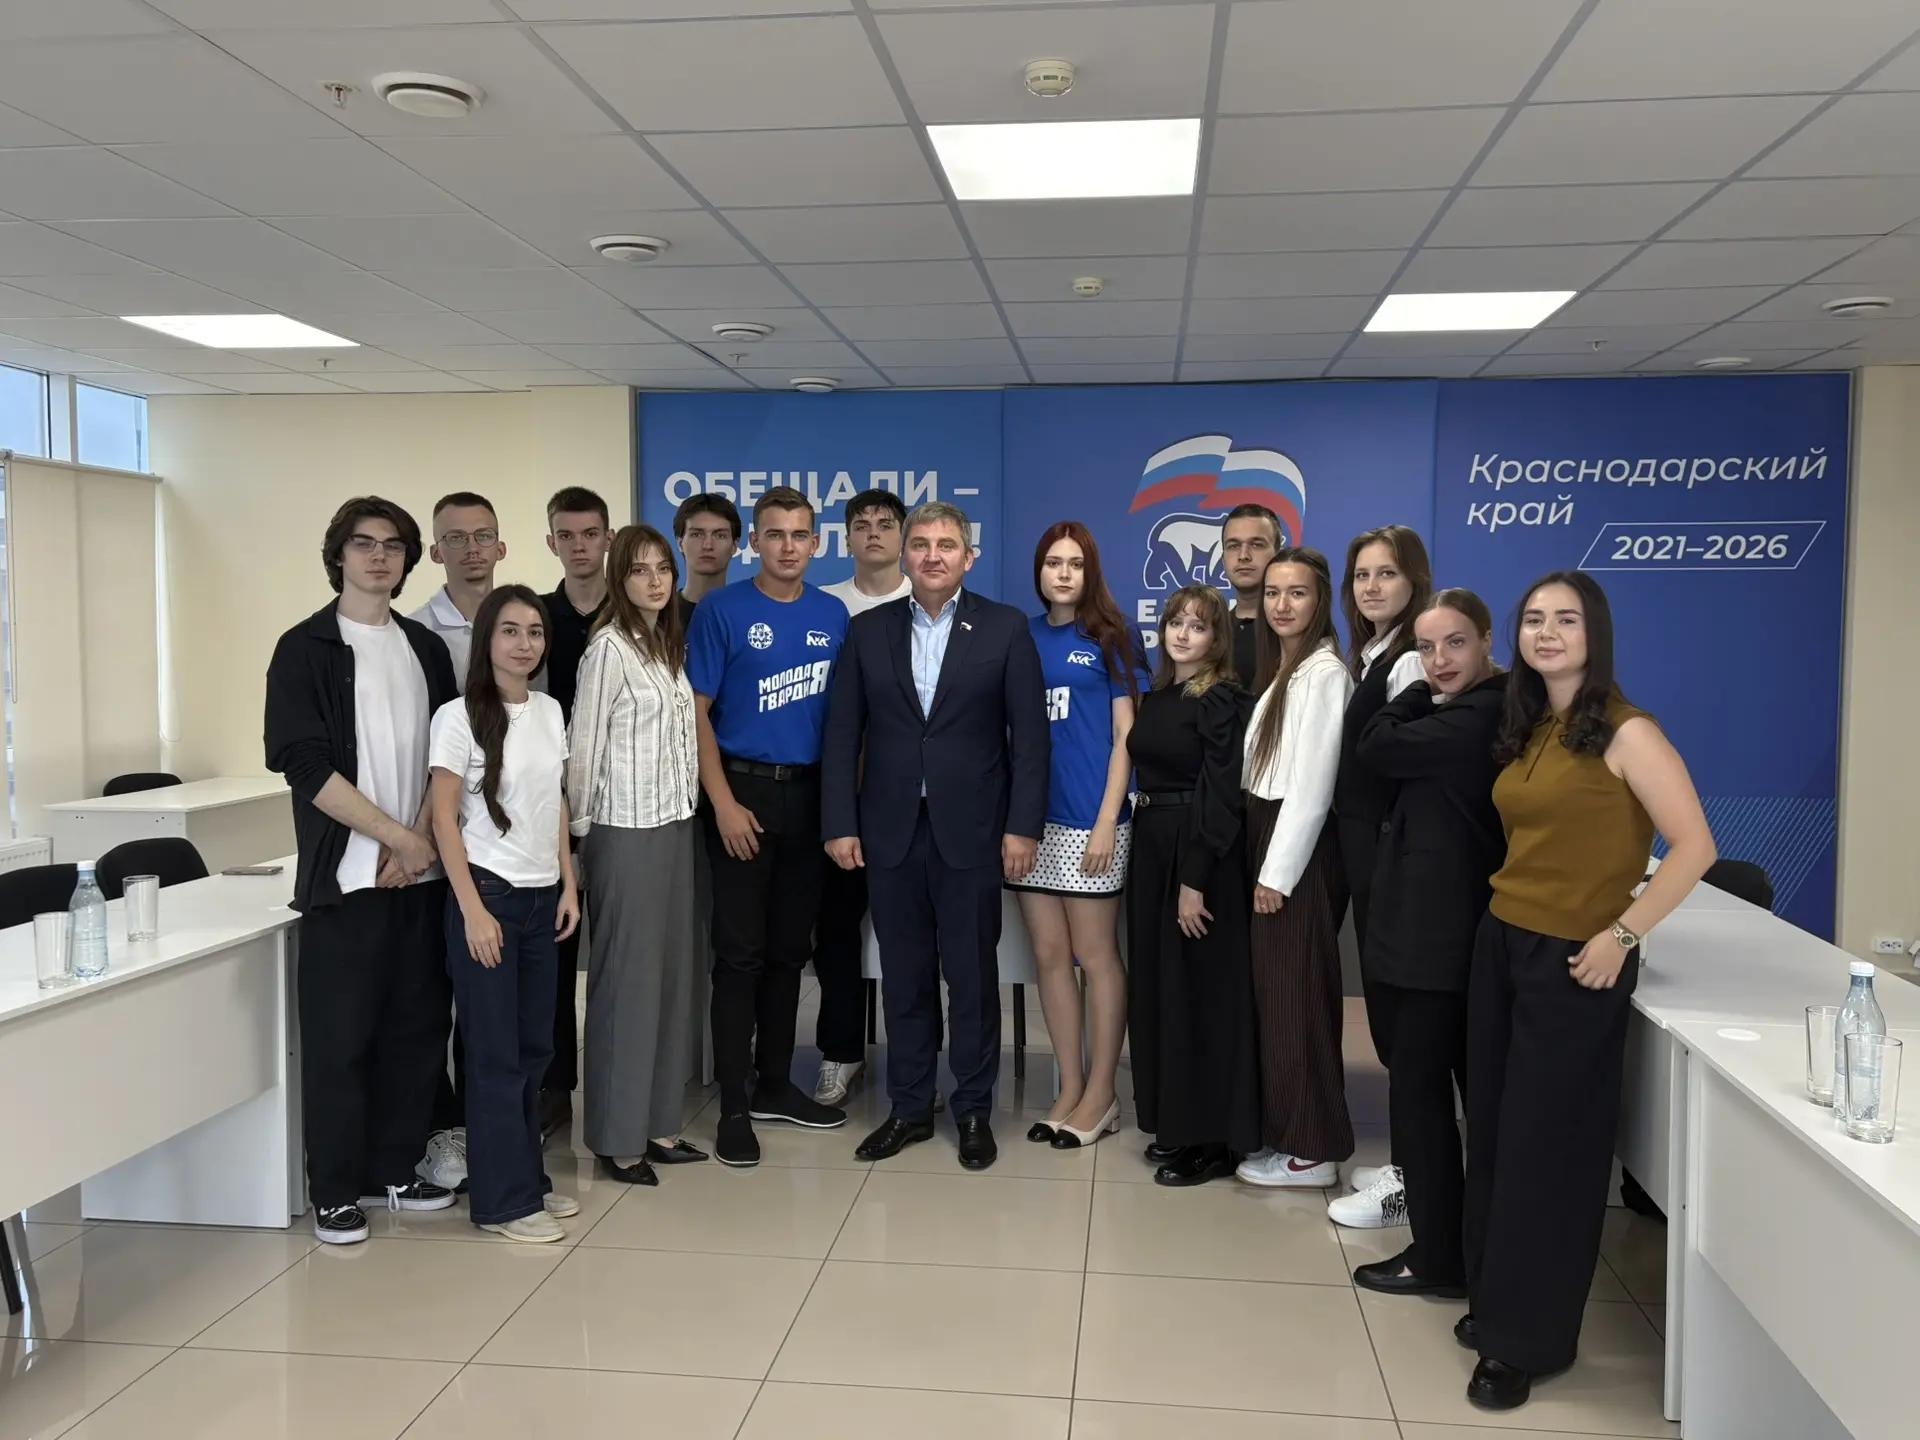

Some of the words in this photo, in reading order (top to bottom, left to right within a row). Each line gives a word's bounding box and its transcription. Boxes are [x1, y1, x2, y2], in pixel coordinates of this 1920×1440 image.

[1468, 446, 1829, 491] Краснодарский
[1466, 493, 1575, 533] край
[1611, 534, 1789, 561] 2021–2026
